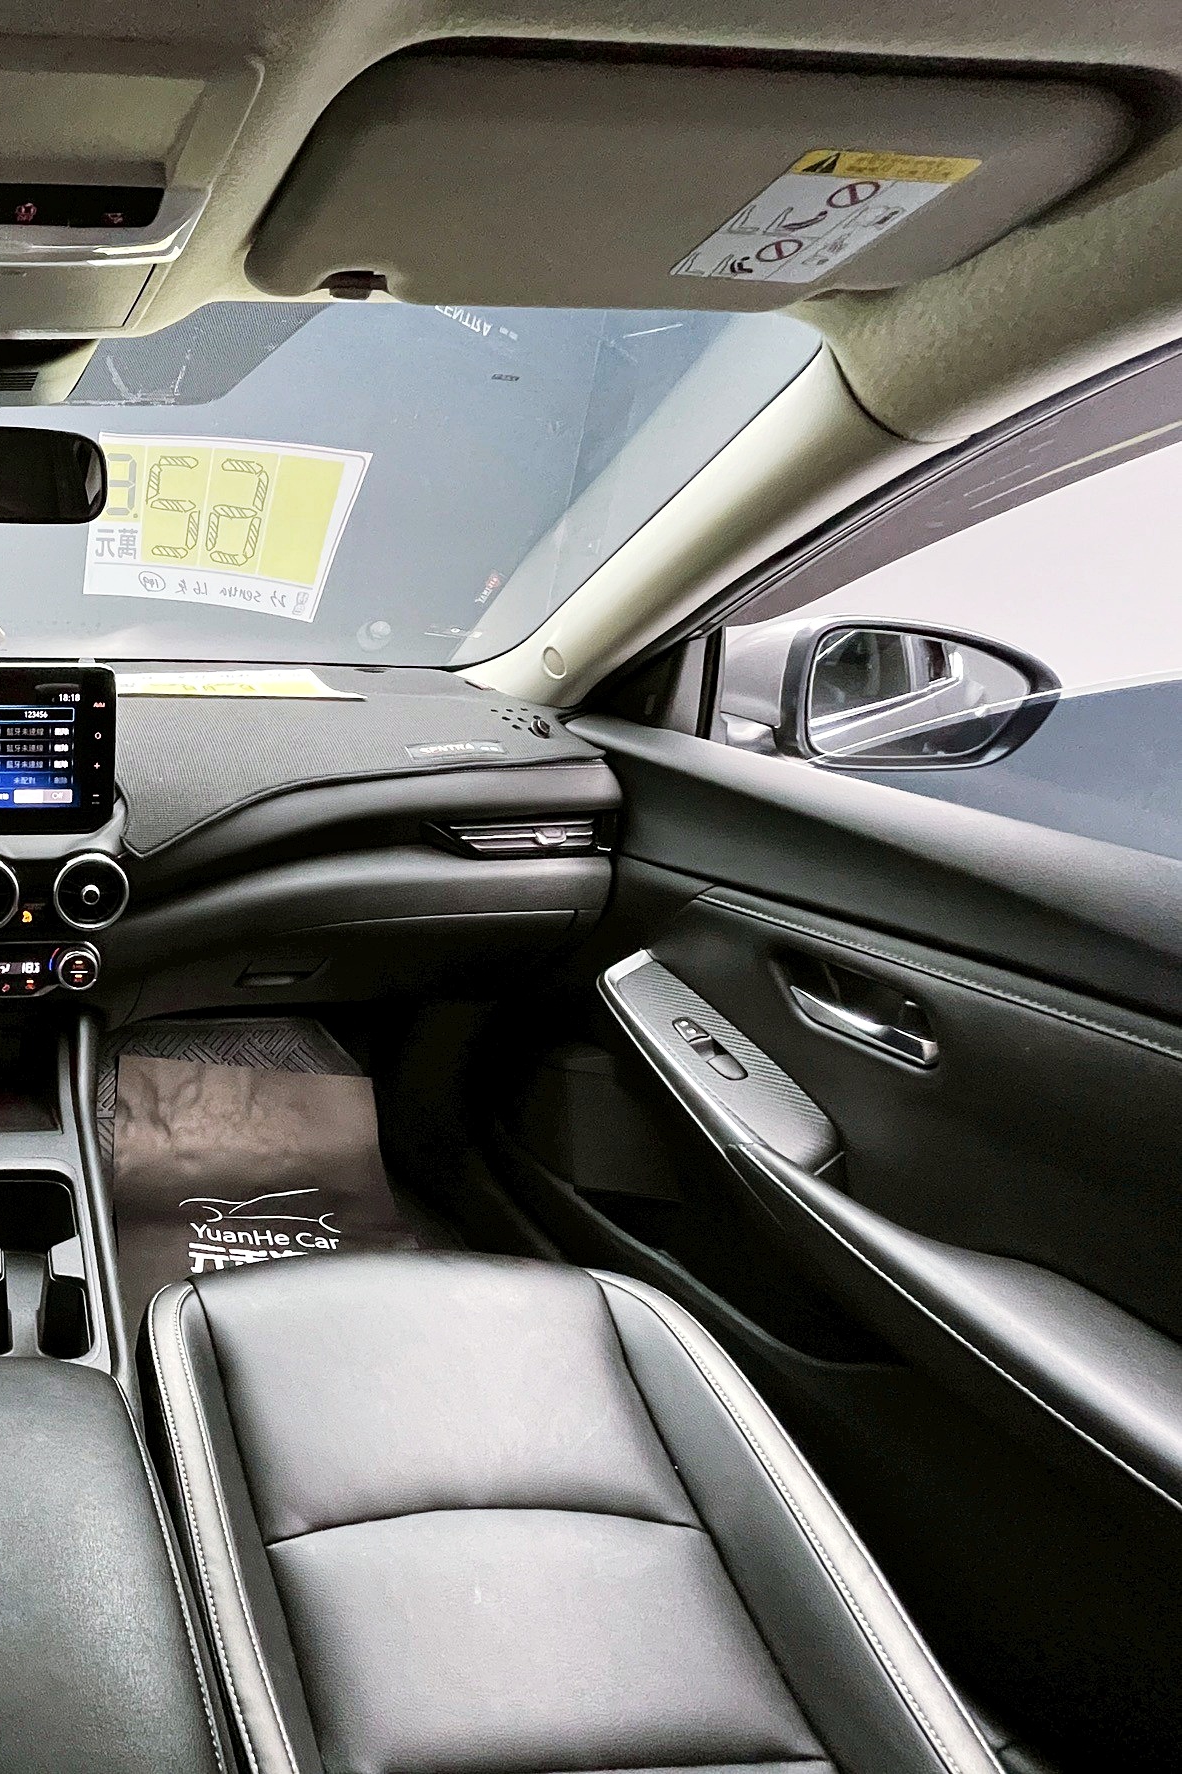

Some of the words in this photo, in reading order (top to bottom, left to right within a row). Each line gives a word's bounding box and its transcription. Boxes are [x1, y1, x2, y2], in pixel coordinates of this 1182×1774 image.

[58, 694, 80, 702] 18:18
[24, 711, 48, 719] 123456
[190, 1222, 290, 1246] YuanHe
[295, 1232, 340, 1250] Car
